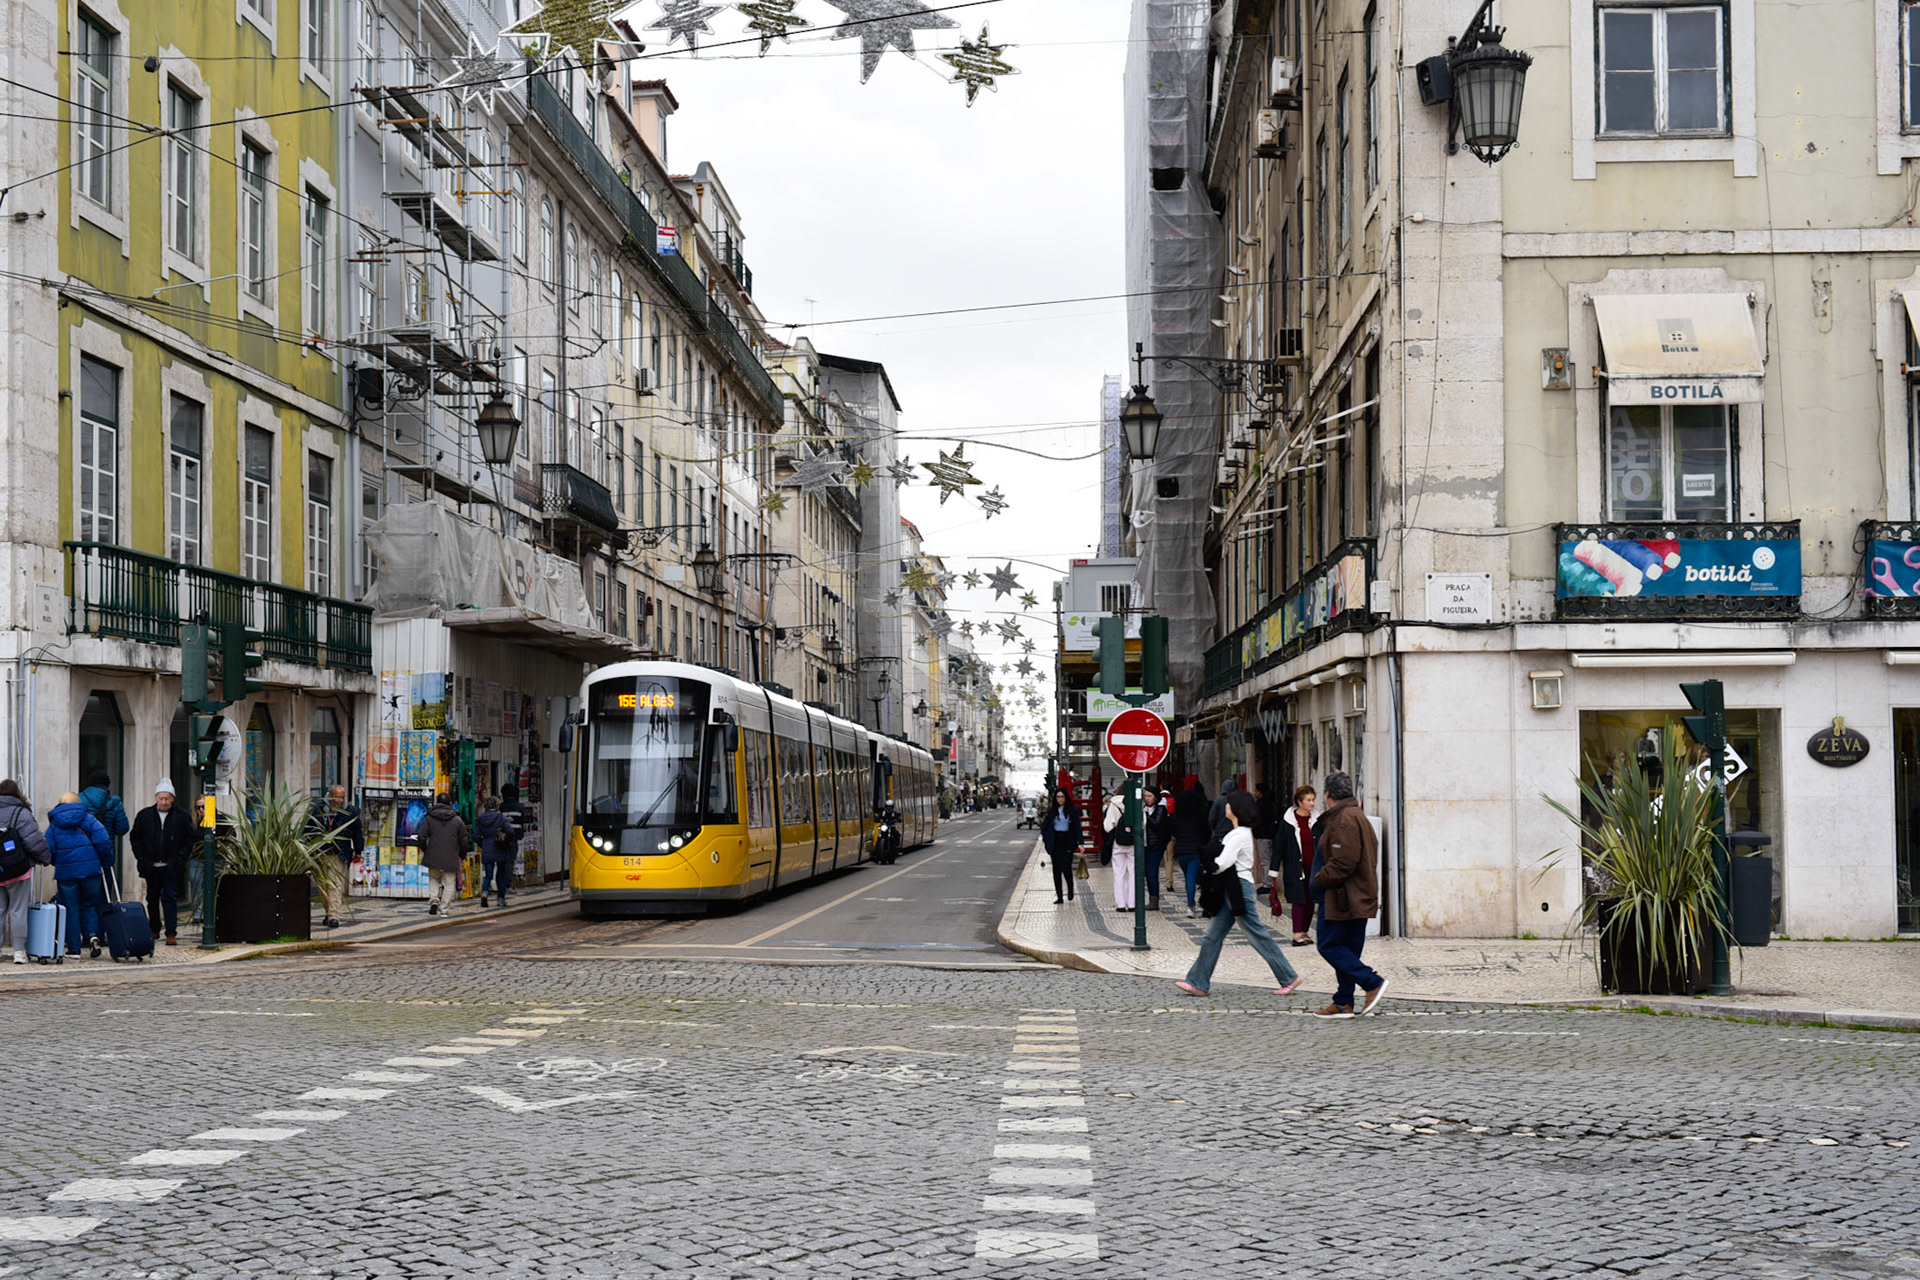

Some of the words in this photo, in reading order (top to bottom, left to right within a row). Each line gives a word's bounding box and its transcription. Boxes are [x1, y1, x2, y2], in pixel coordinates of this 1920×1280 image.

[1650, 382, 1724, 399] BOTILÃ
[1453, 595, 1465, 603] DA
[618, 694, 636, 707] 15E
[717, 695, 728, 703] 614
[1816, 737, 1863, 752] ZEVA
[623, 857, 641, 866] 614
